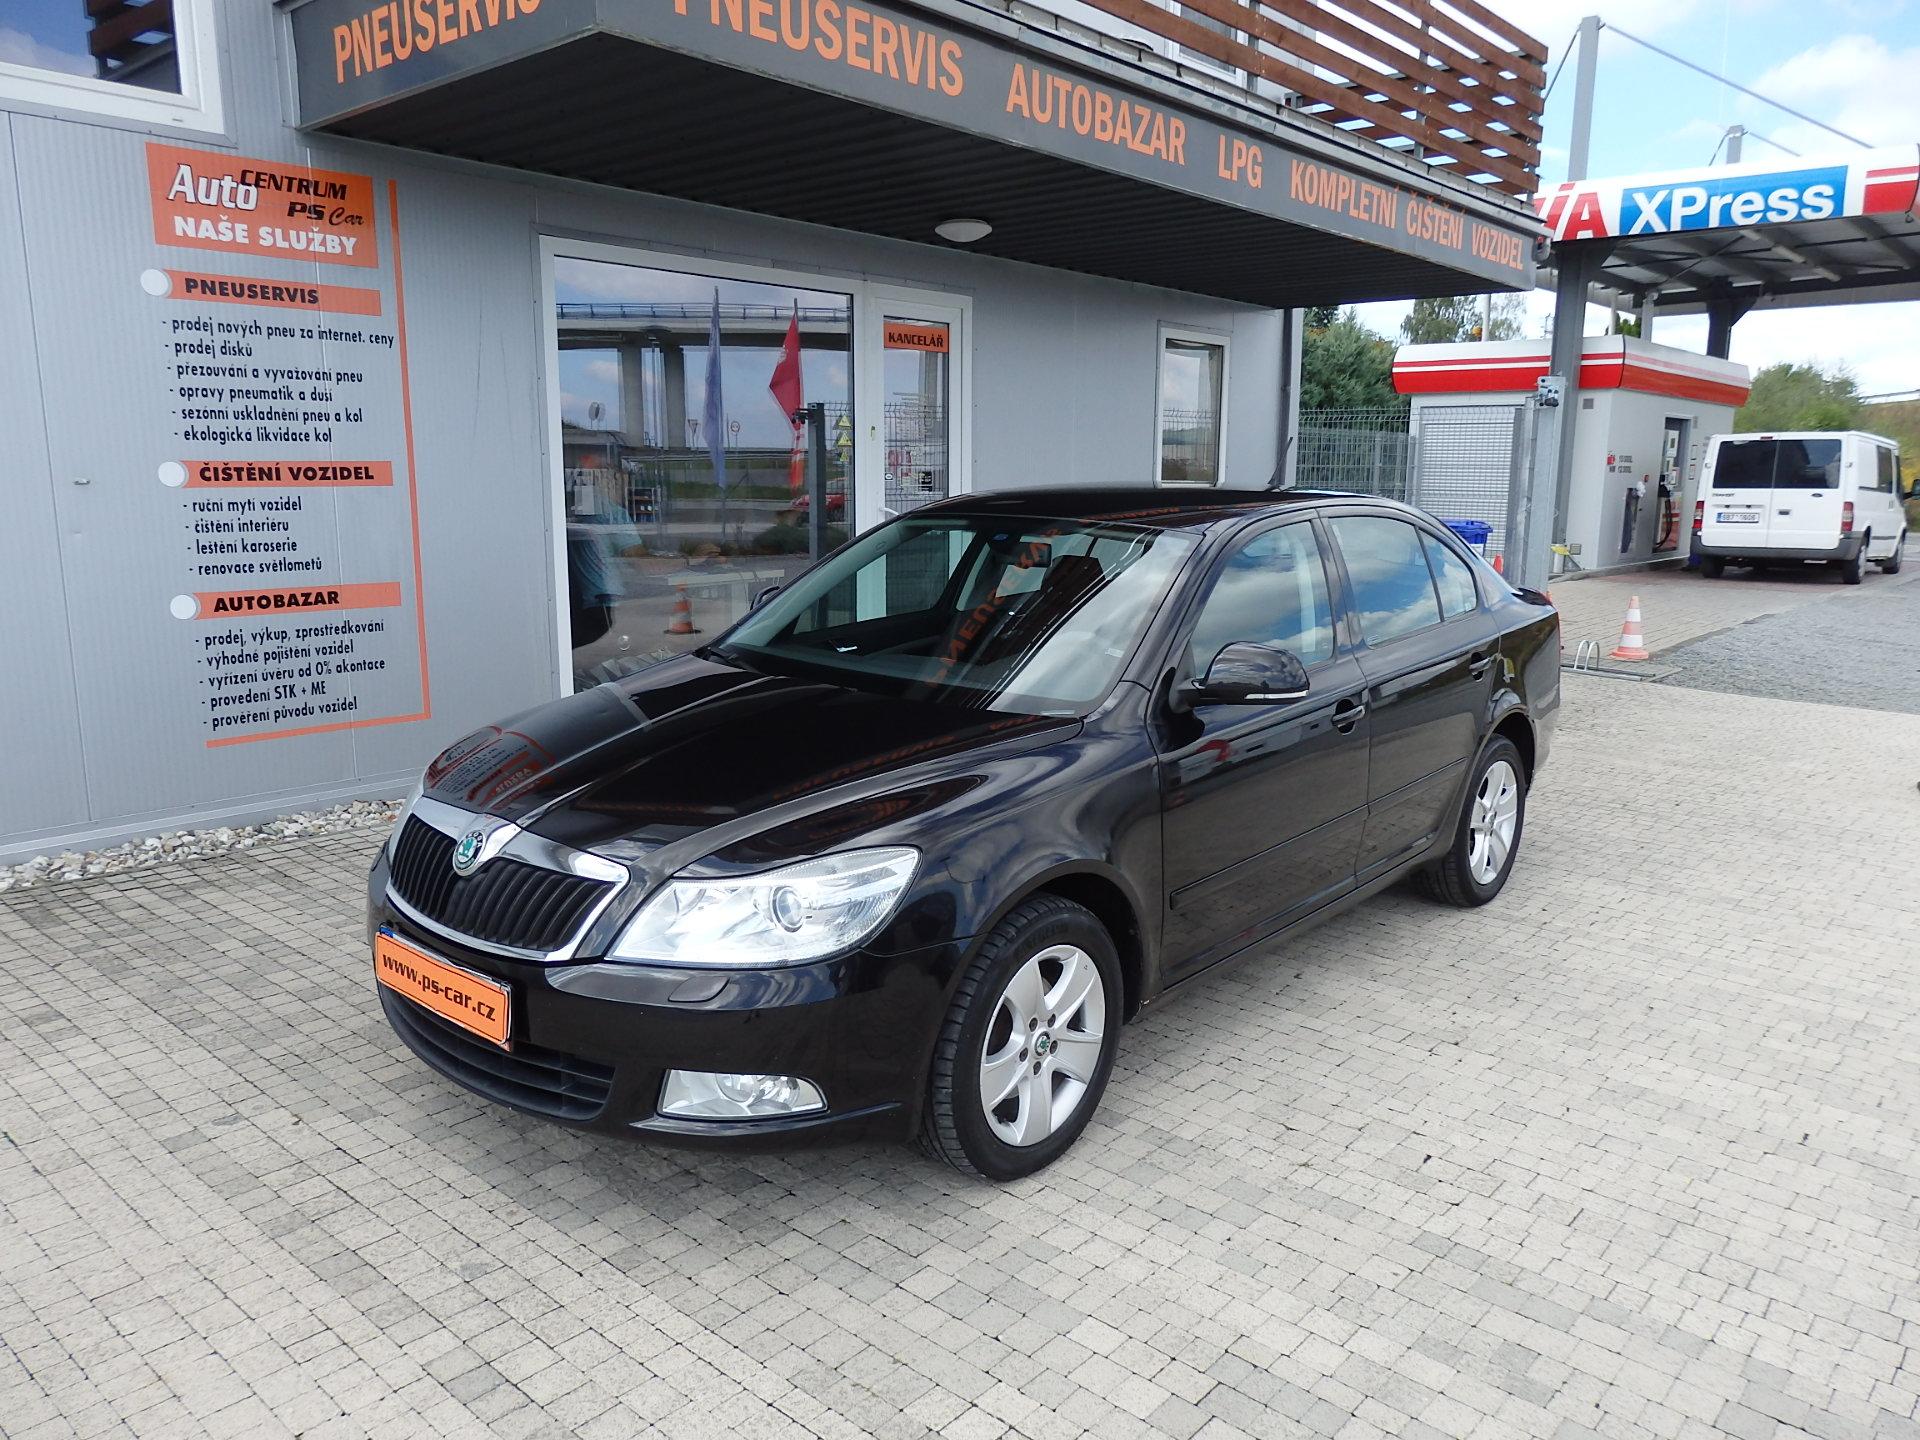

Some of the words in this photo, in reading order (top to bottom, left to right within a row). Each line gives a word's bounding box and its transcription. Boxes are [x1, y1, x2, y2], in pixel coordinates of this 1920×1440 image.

[1006, 62, 1186, 166] AUTOBAZAR
[1218, 134, 1262, 188] LPG
[1290, 159, 1399, 229] KOMPLETNÍ
[1406, 190, 1466, 250] ČIŠTĚNÍ
[1472, 222, 1524, 271] VOZIDEL
[167, 163, 258, 211] Auto
[240, 169, 347, 200] CENTRUM
[287, 201, 326, 221] PS
[328, 206, 366, 226] Car
[1628, 184, 1835, 236] XPress
[174, 213, 249, 244] NAŠE
[258, 226, 357, 256] SLUŽBY
[185, 278, 319, 304] PNEUSERVIS
[172, 316, 214, 336] prodej
[217, 320, 262, 338] nových
[267, 326, 295, 340] pneu
[299, 328, 314, 339] za
[317, 325, 366, 343] internet.
[369, 333, 394, 348] ceny
[888, 331, 944, 348] KANCELÁŘ
[174, 338, 216, 359] prodej
[220, 340, 253, 357] disků
[177, 362, 248, 379] přezouvání
[252, 368, 259, 379] a
[264, 367, 332, 383] vyvažování
[336, 371, 363, 385] pneu
[179, 387, 224, 402] opravy
[229, 385, 294, 402] pneumatik
[298, 391, 306, 400] a
[181, 405, 229, 420] sezónní
[233, 404, 299, 421] uskladnění
[302, 411, 330, 425] pneu
[334, 412, 341, 422] a
[345, 407, 363, 422] kol
[184, 425, 252, 445] ekologická
[256, 426, 310, 442] likvidace
[314, 427, 332, 442] kol
[200, 462, 282, 482] ČIŠTĚNÍ
[288, 465, 374, 481] VOZIDEL
[192, 498, 224, 512] ruční
[260, 496, 302, 511] vozidel
[194, 517, 234, 533] čištění
[238, 517, 289, 532] interiéru
[196, 539, 238, 554] leštění
[241, 537, 298, 553] karoserie
[198, 562, 255, 575] renovace
[259, 557, 322, 573] světlometů
[213, 590, 340, 613] AUTOBAZAR
[204, 629, 247, 650] prodej,
[251, 626, 291, 645] výkup,
[295, 619, 384, 641] zprostředkování
[206, 648, 259, 670] výhodné
[263, 645, 311, 665] pojištění
[315, 639, 354, 655] vozidel
[208, 669, 258, 690] vyřízení
[261, 667, 294, 681] úvěru
[298, 662, 312, 677] od
[315, 660, 332, 675] 0%
[336, 659, 385, 673] akontace
[211, 687, 271, 711] provedení
[274, 683, 297, 700] STK
[301, 687, 307, 695] +
[311, 681, 326, 695] ME
[212, 707, 270, 731] prověření
[273, 702, 315, 723] původu
[319, 696, 358, 713] vozidel
[382, 954, 496, 1022] www.ps-car.cz
